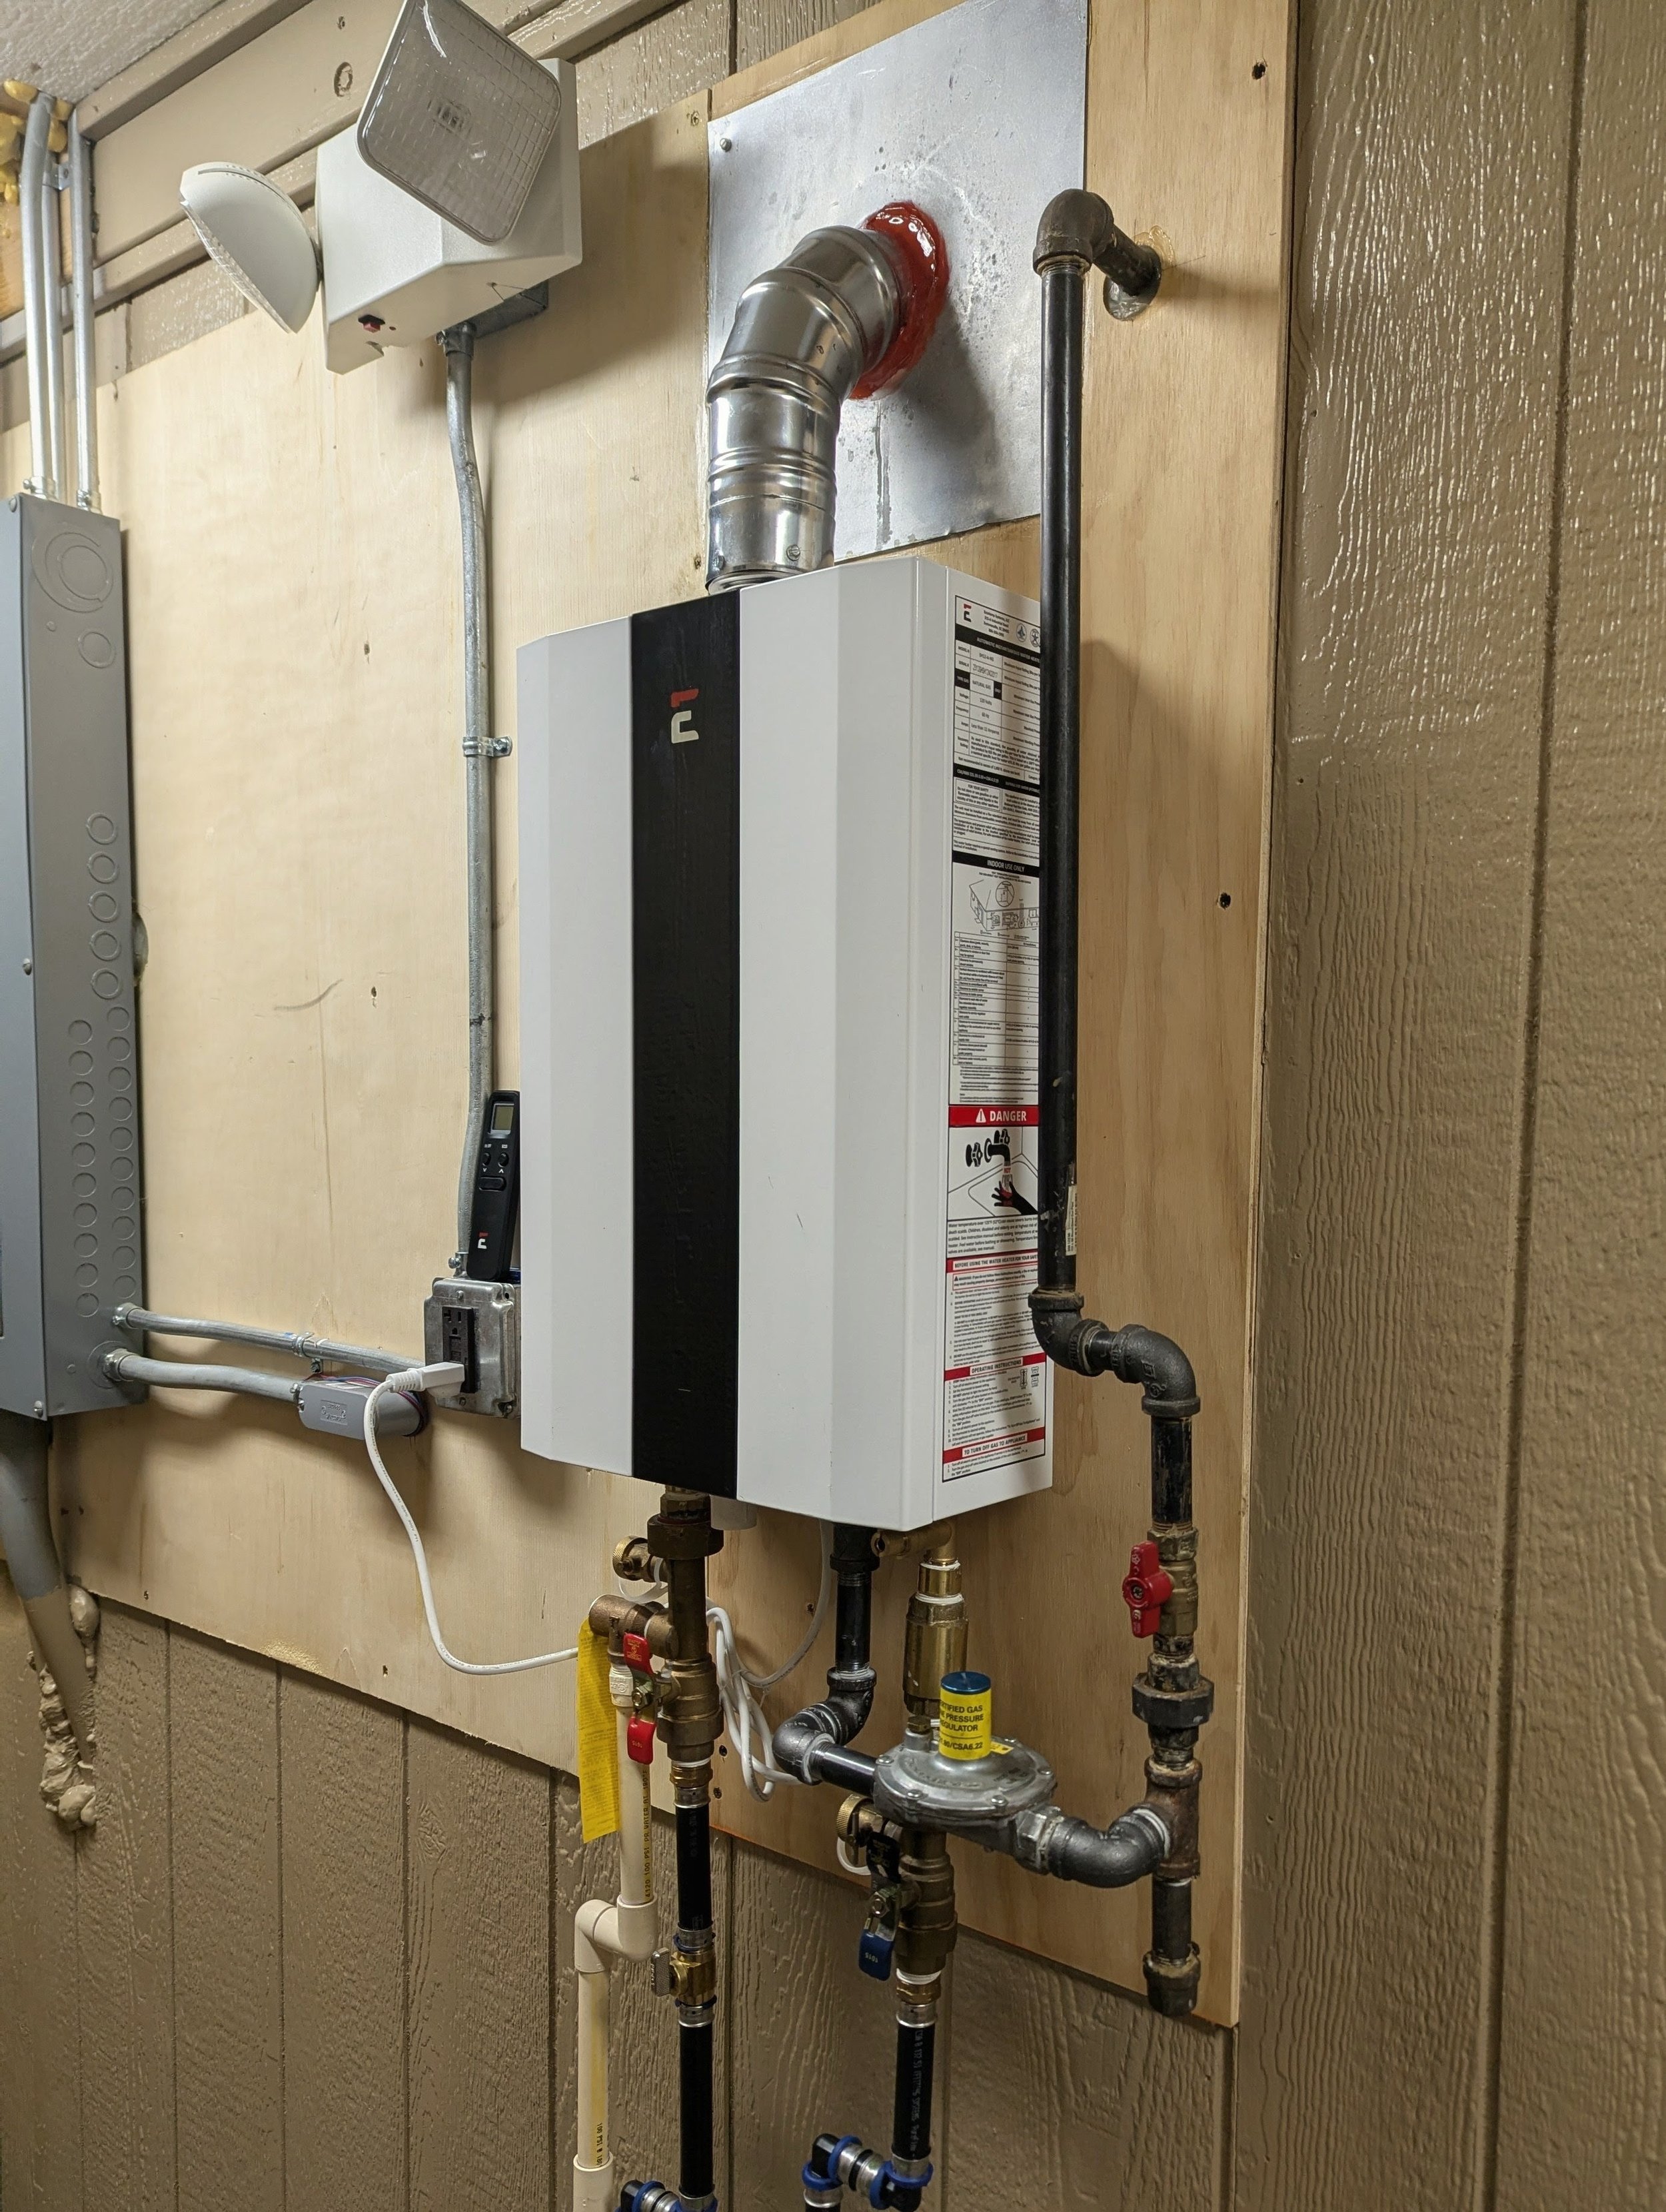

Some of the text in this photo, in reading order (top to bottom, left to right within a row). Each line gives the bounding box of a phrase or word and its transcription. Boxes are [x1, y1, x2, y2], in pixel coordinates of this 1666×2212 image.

[988, 859, 1004, 869] INDOOR
[990, 1110, 1027, 1121] DANGER
[972, 1359, 1022, 1374] OPERATING INSTRUCTIONS
[1006, 1435, 1025, 1445] APPLIANCE
[946, 1713, 984, 1722] PRESSURE
[940, 1720, 978, 1732] EGULATOR
